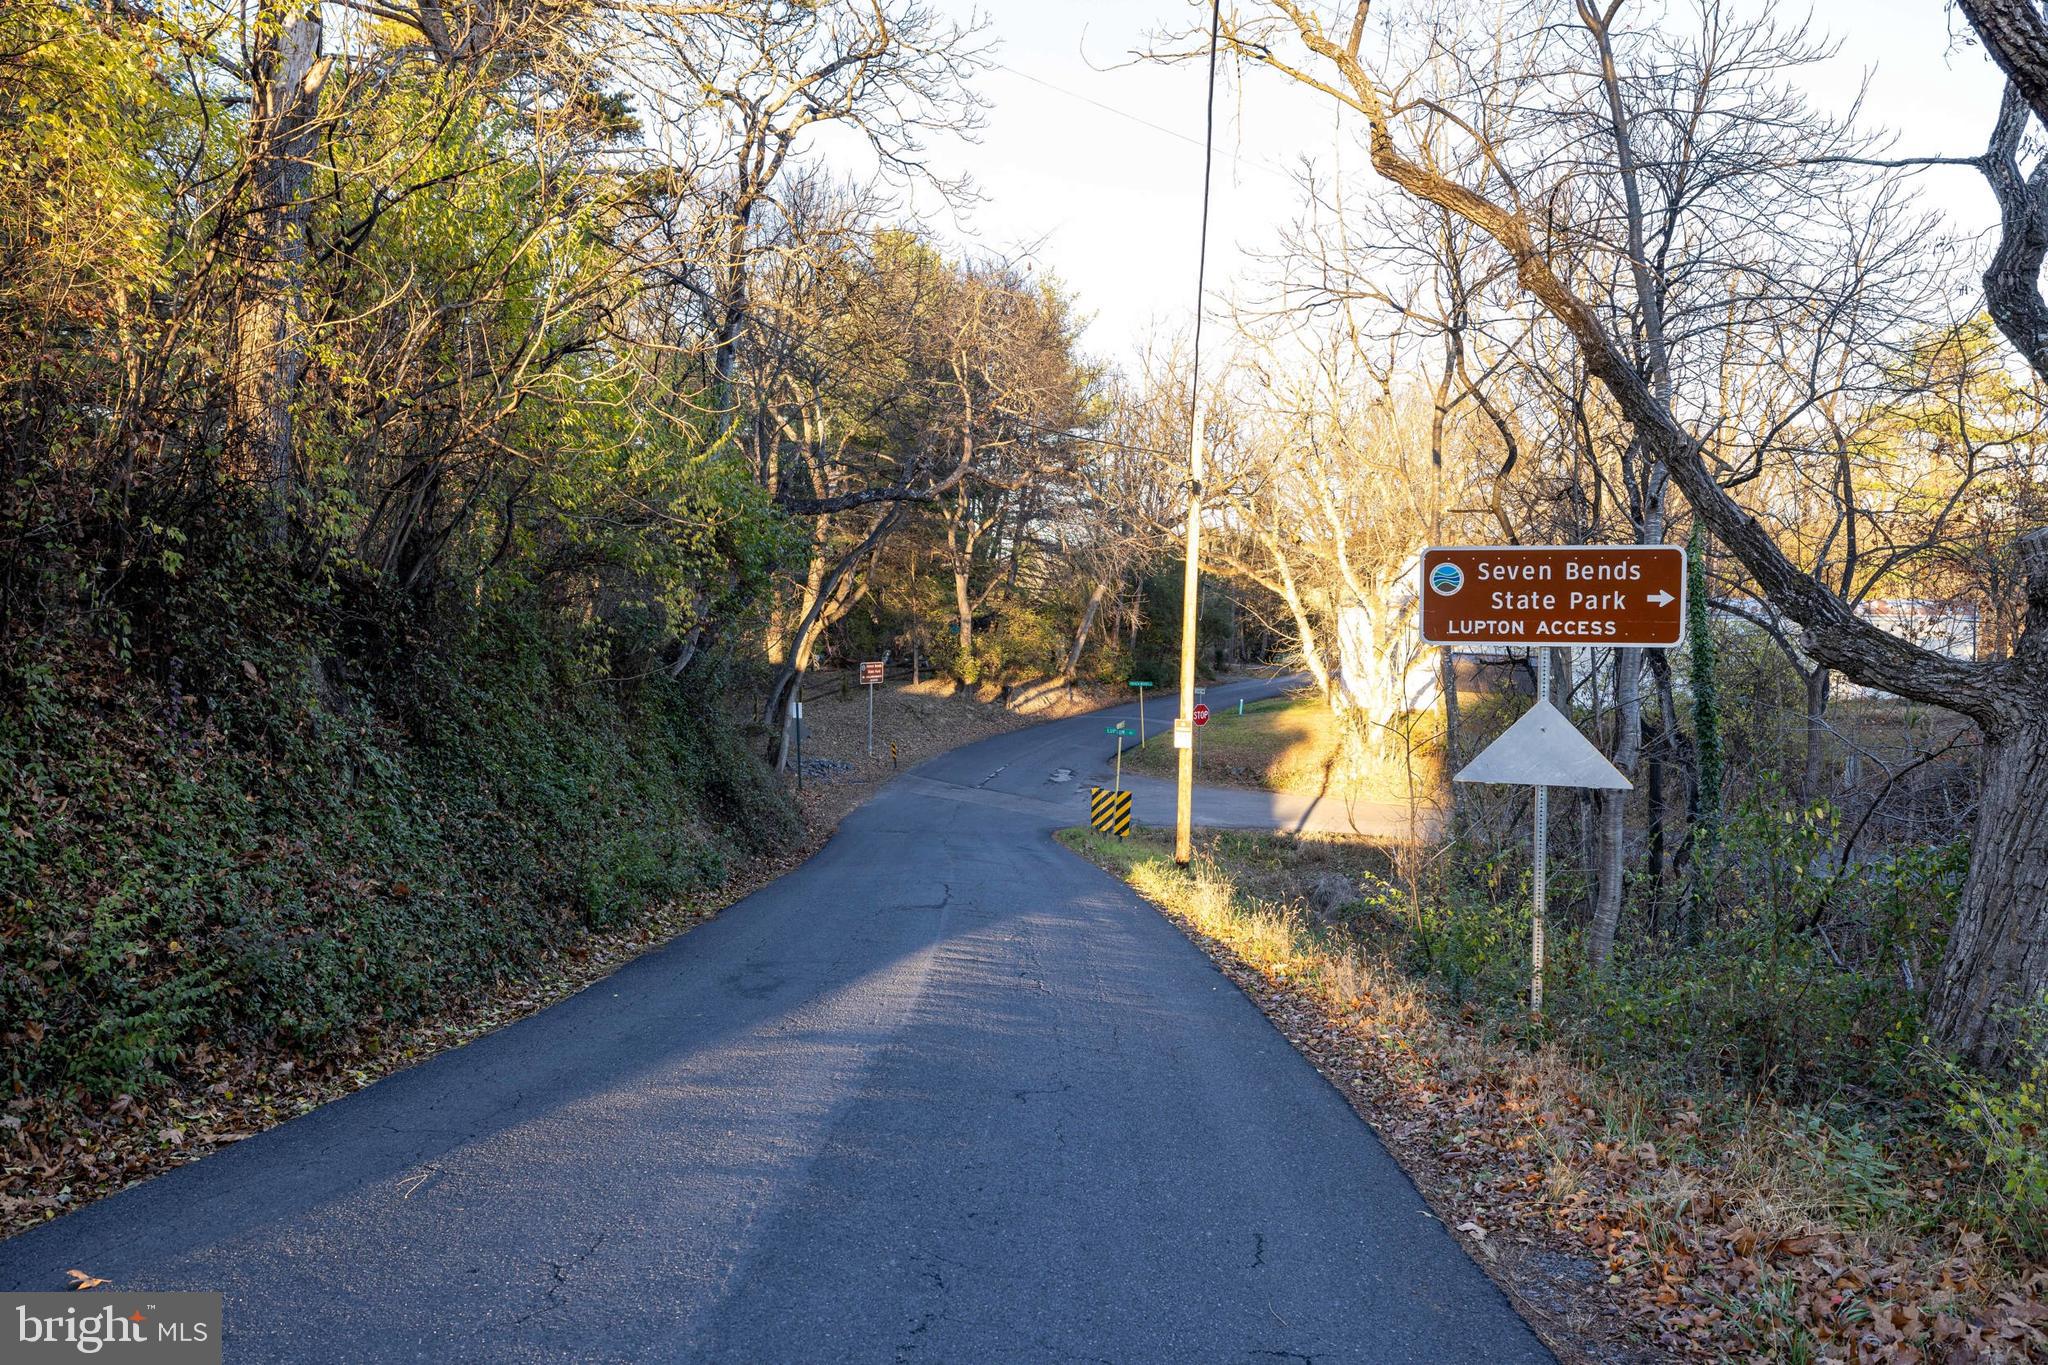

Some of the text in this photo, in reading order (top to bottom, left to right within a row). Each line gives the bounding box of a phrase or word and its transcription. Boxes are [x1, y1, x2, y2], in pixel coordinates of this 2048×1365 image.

[1477, 561, 1641, 581] Seven Bends
[1491, 591, 1626, 610] State Park
[1448, 620, 1617, 636] LUPTON ACCESS
[1193, 711, 1209, 720] STOP
